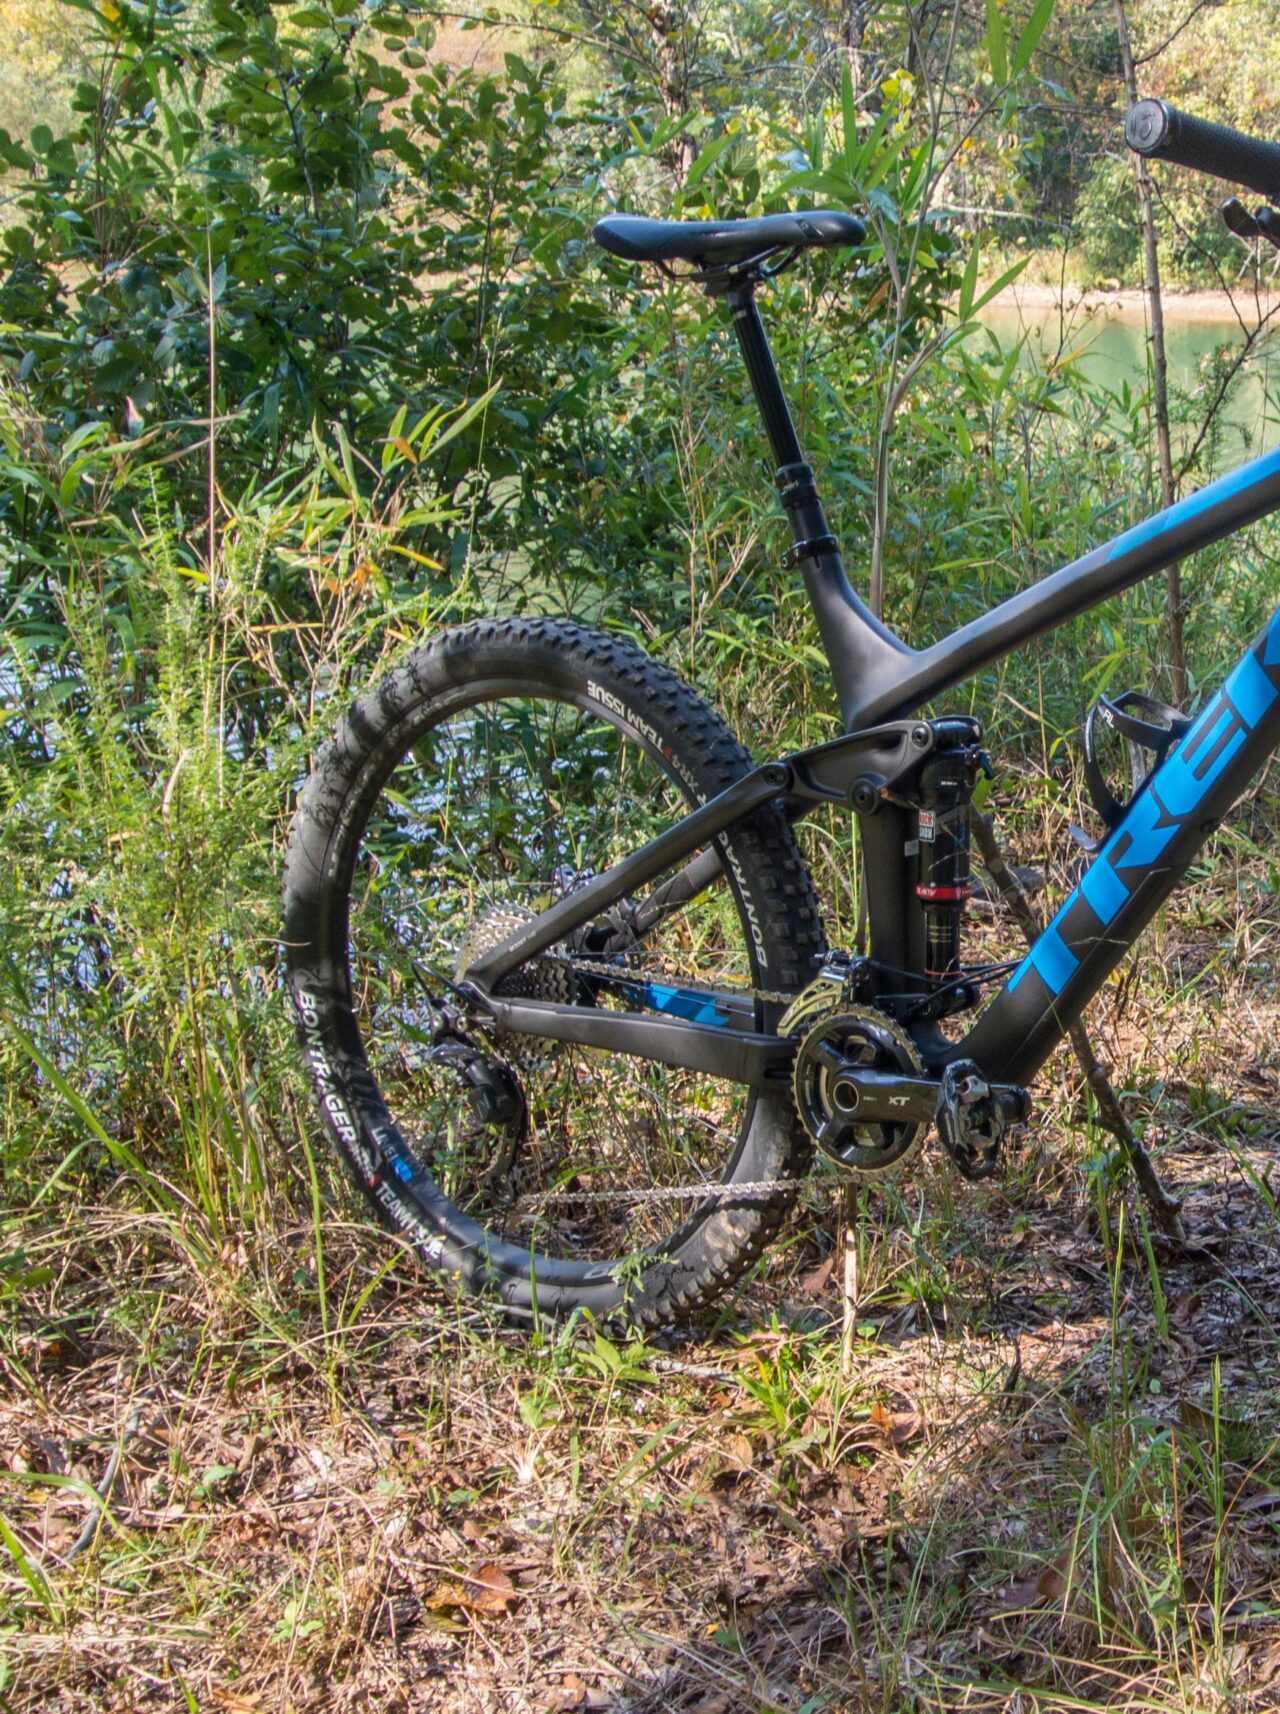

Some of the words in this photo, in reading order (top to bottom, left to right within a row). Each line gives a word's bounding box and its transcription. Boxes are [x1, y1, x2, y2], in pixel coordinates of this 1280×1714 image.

[587, 680, 625, 716] ISSUE
[627, 708, 663, 753] TEAM
[1103, 708, 1114, 728] RL
[298, 989, 357, 1142] BONTRAGER
[888, 1096, 910, 1106] XT
